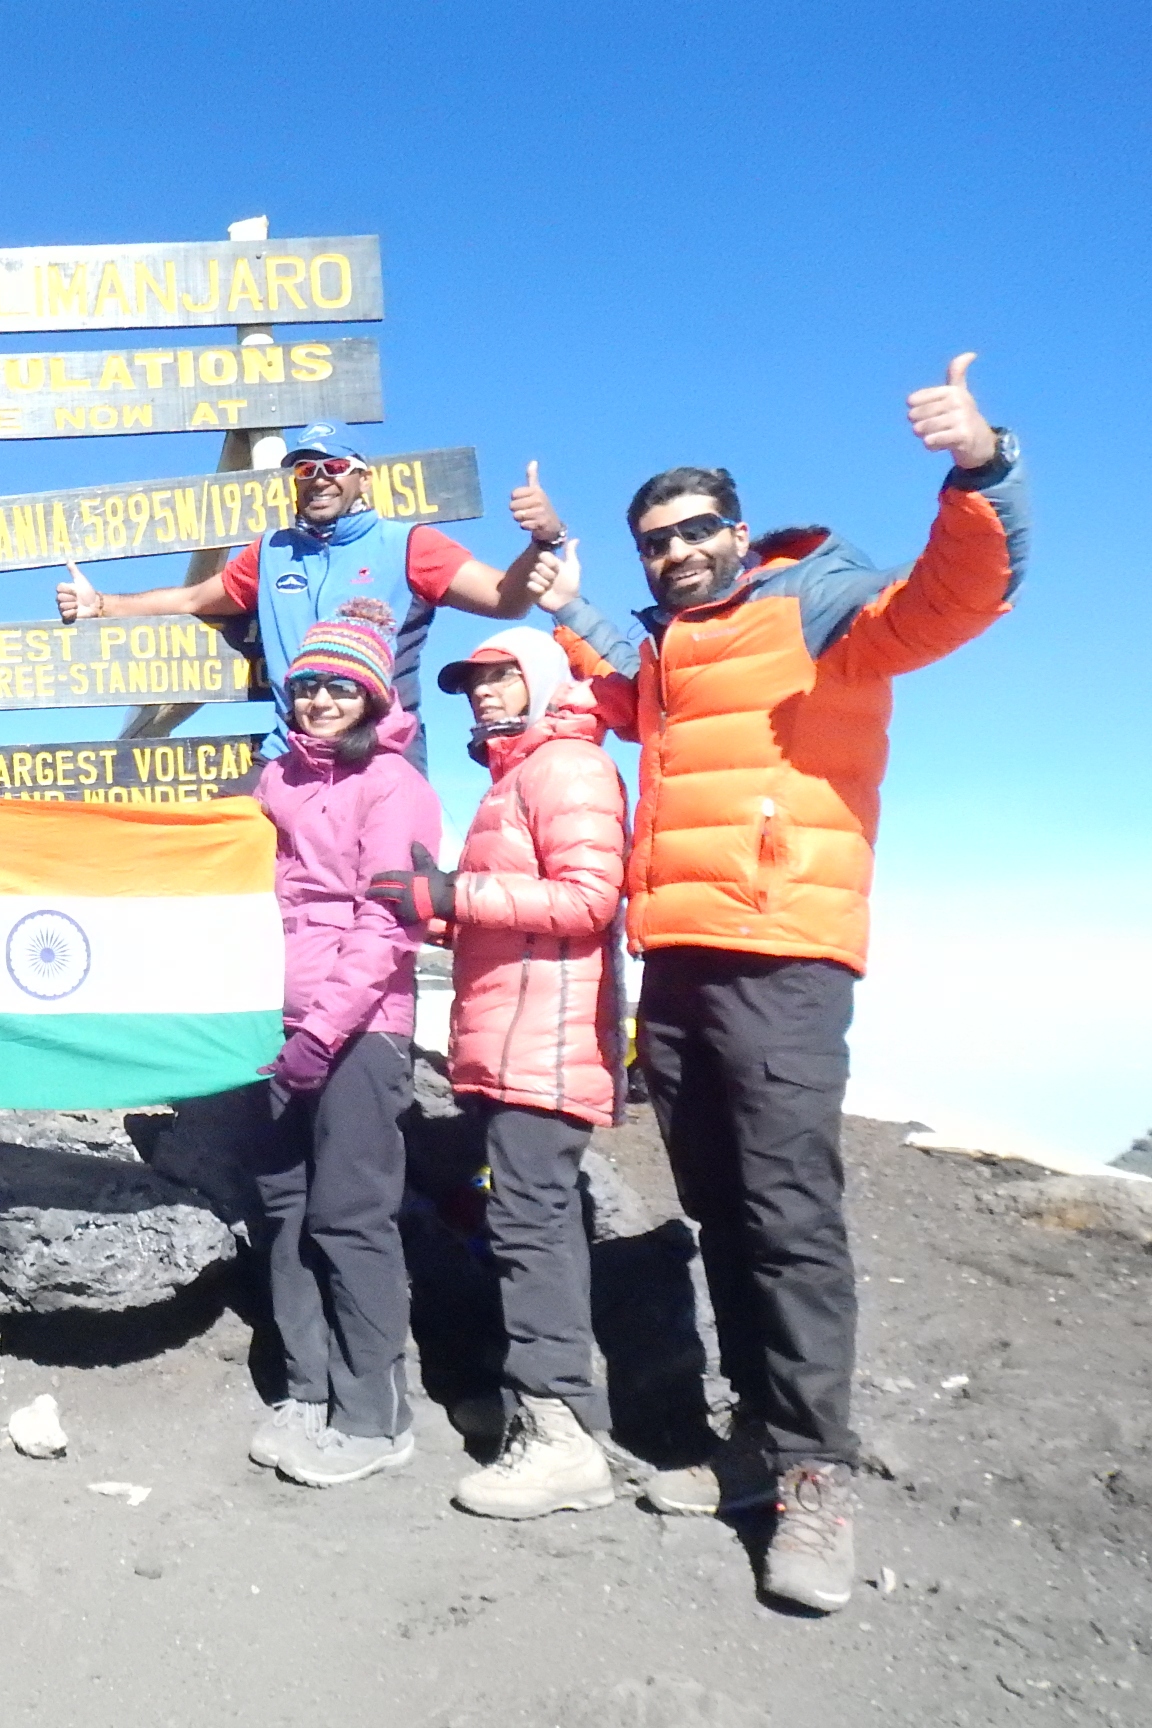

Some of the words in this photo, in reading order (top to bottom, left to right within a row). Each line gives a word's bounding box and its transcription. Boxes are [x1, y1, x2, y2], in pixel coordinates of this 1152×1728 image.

[55, 404, 153, 430] NOW
[191, 399, 248, 427] AT
[100, 622, 224, 661] POINT
